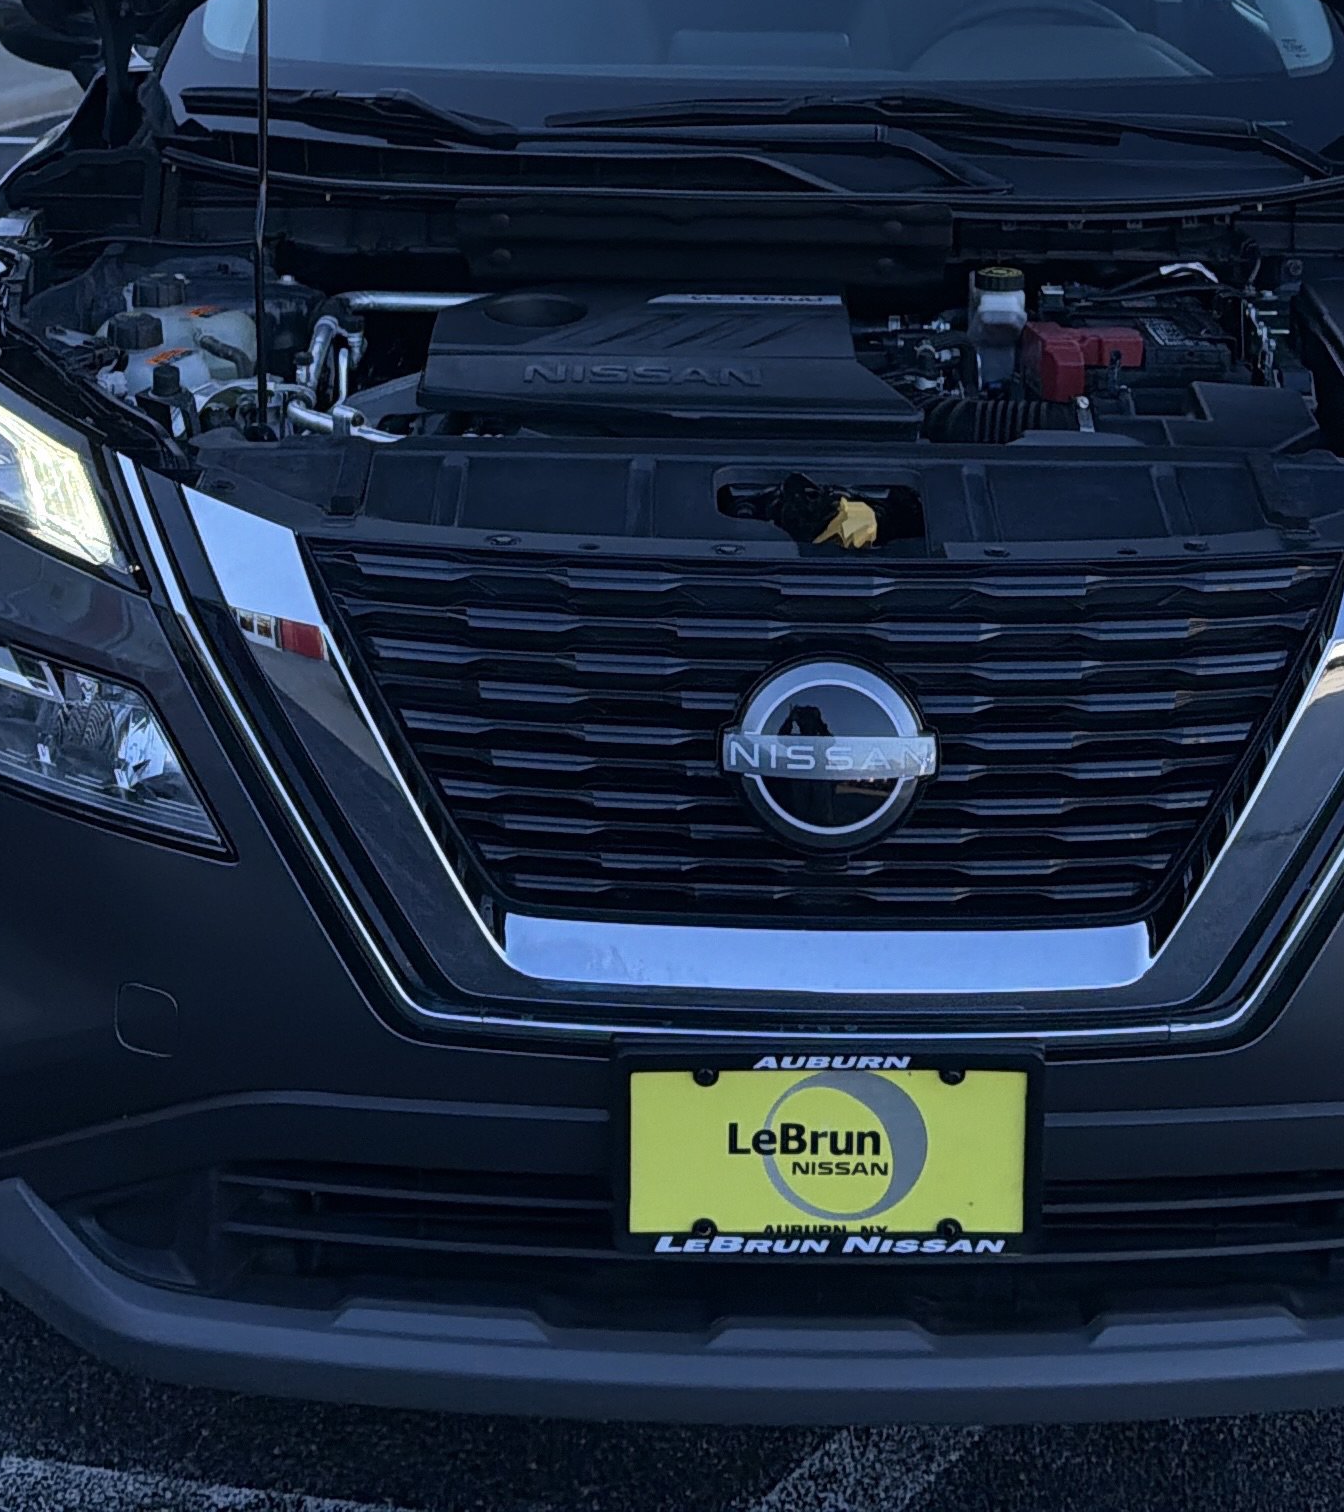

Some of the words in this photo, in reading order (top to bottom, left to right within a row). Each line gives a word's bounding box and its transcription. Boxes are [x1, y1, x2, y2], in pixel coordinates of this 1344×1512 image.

[523, 363, 762, 387] NISSAN
[729, 741, 932, 771] NISSAN
[753, 1055, 912, 1070] AUBURN
[727, 1122, 881, 1156] LeBrun
[792, 1161, 889, 1176] NISSAN
